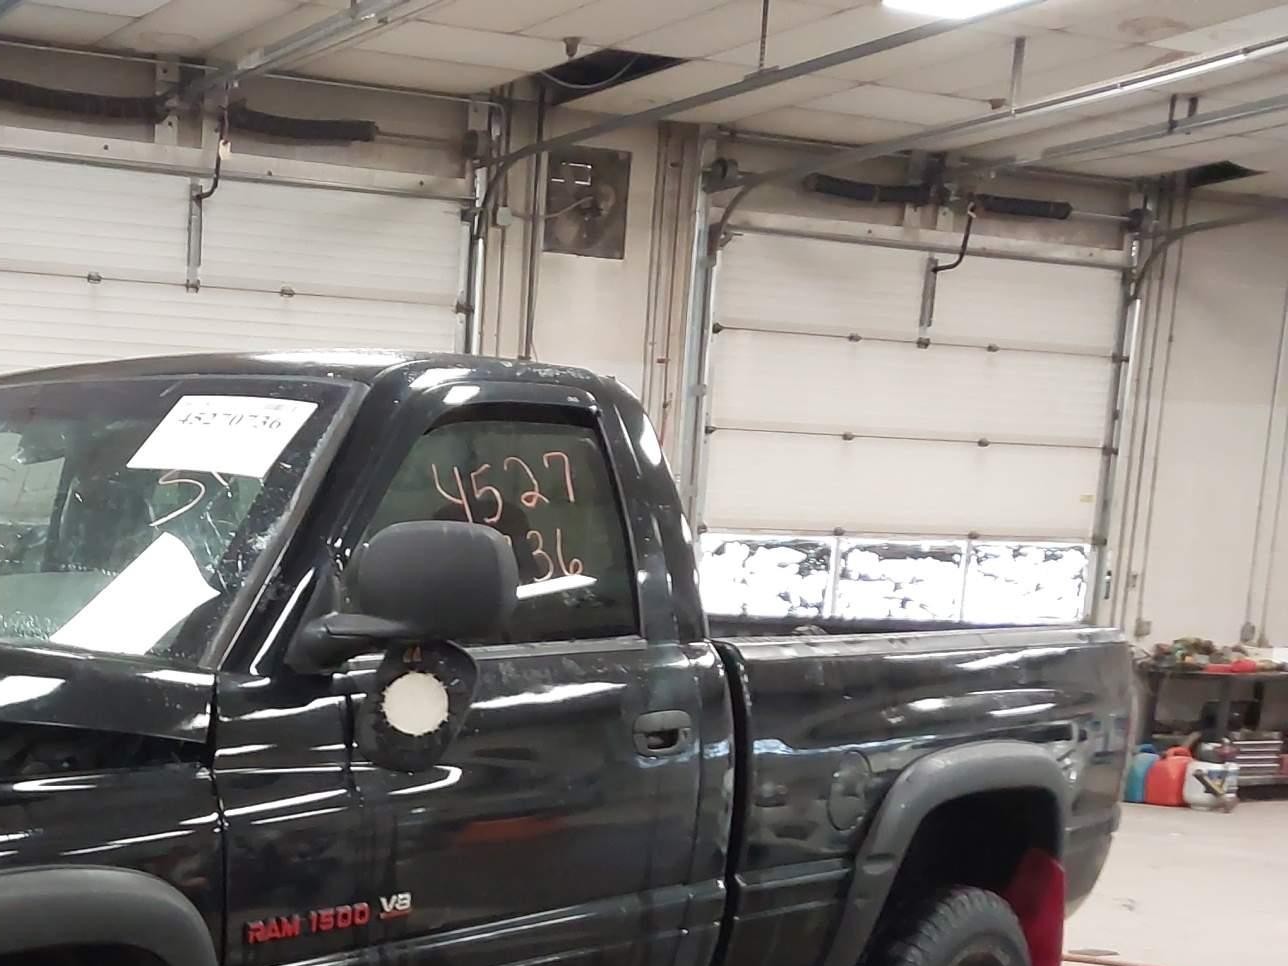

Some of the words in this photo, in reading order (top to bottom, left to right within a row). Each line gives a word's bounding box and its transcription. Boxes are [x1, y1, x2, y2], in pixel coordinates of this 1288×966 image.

[431, 451, 575, 524] 4527
[503, 527, 584, 583] 36
[247, 914, 301, 945] RAM
[309, 901, 370, 934] 1500
[379, 891, 412, 914] V8
